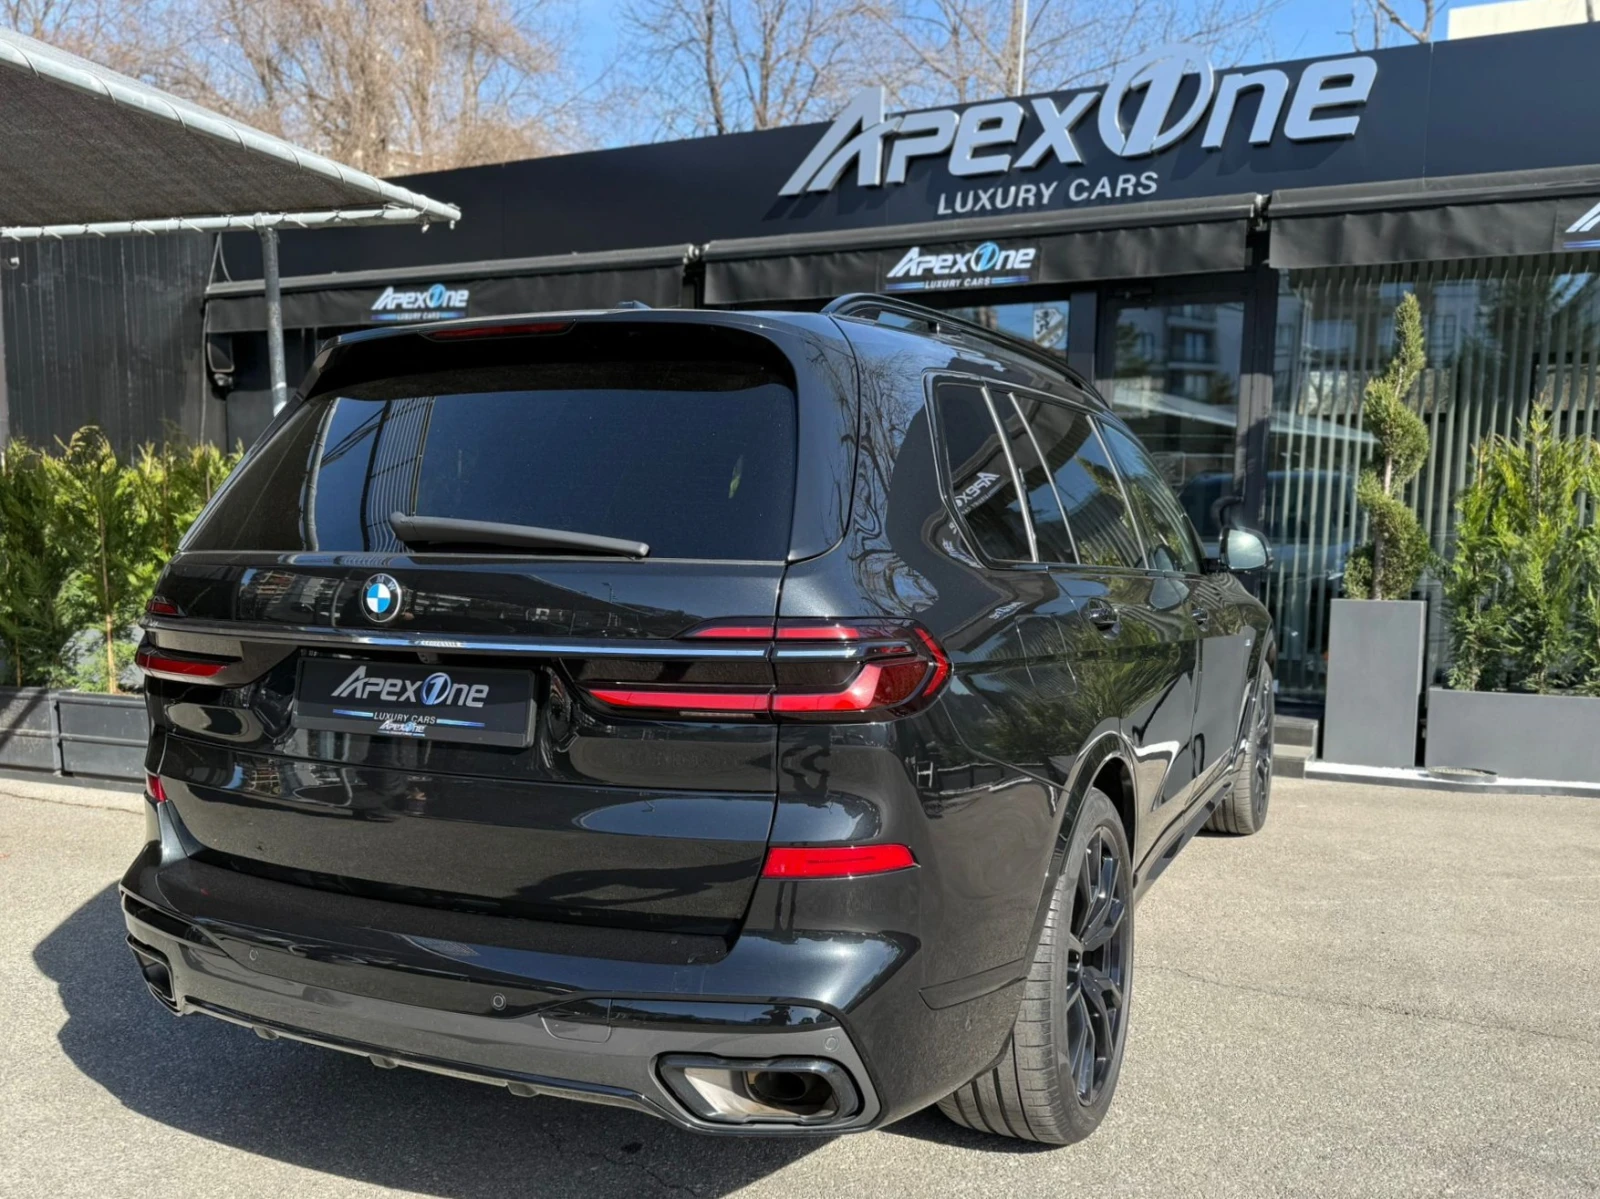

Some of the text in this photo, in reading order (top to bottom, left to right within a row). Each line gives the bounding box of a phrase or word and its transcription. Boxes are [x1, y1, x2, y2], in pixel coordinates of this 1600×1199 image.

[937, 171, 1158, 215] LUXURY CARS
[925, 275, 991, 289] LUXURY CARS
[373, 711, 436, 725] LUXURY CARS
